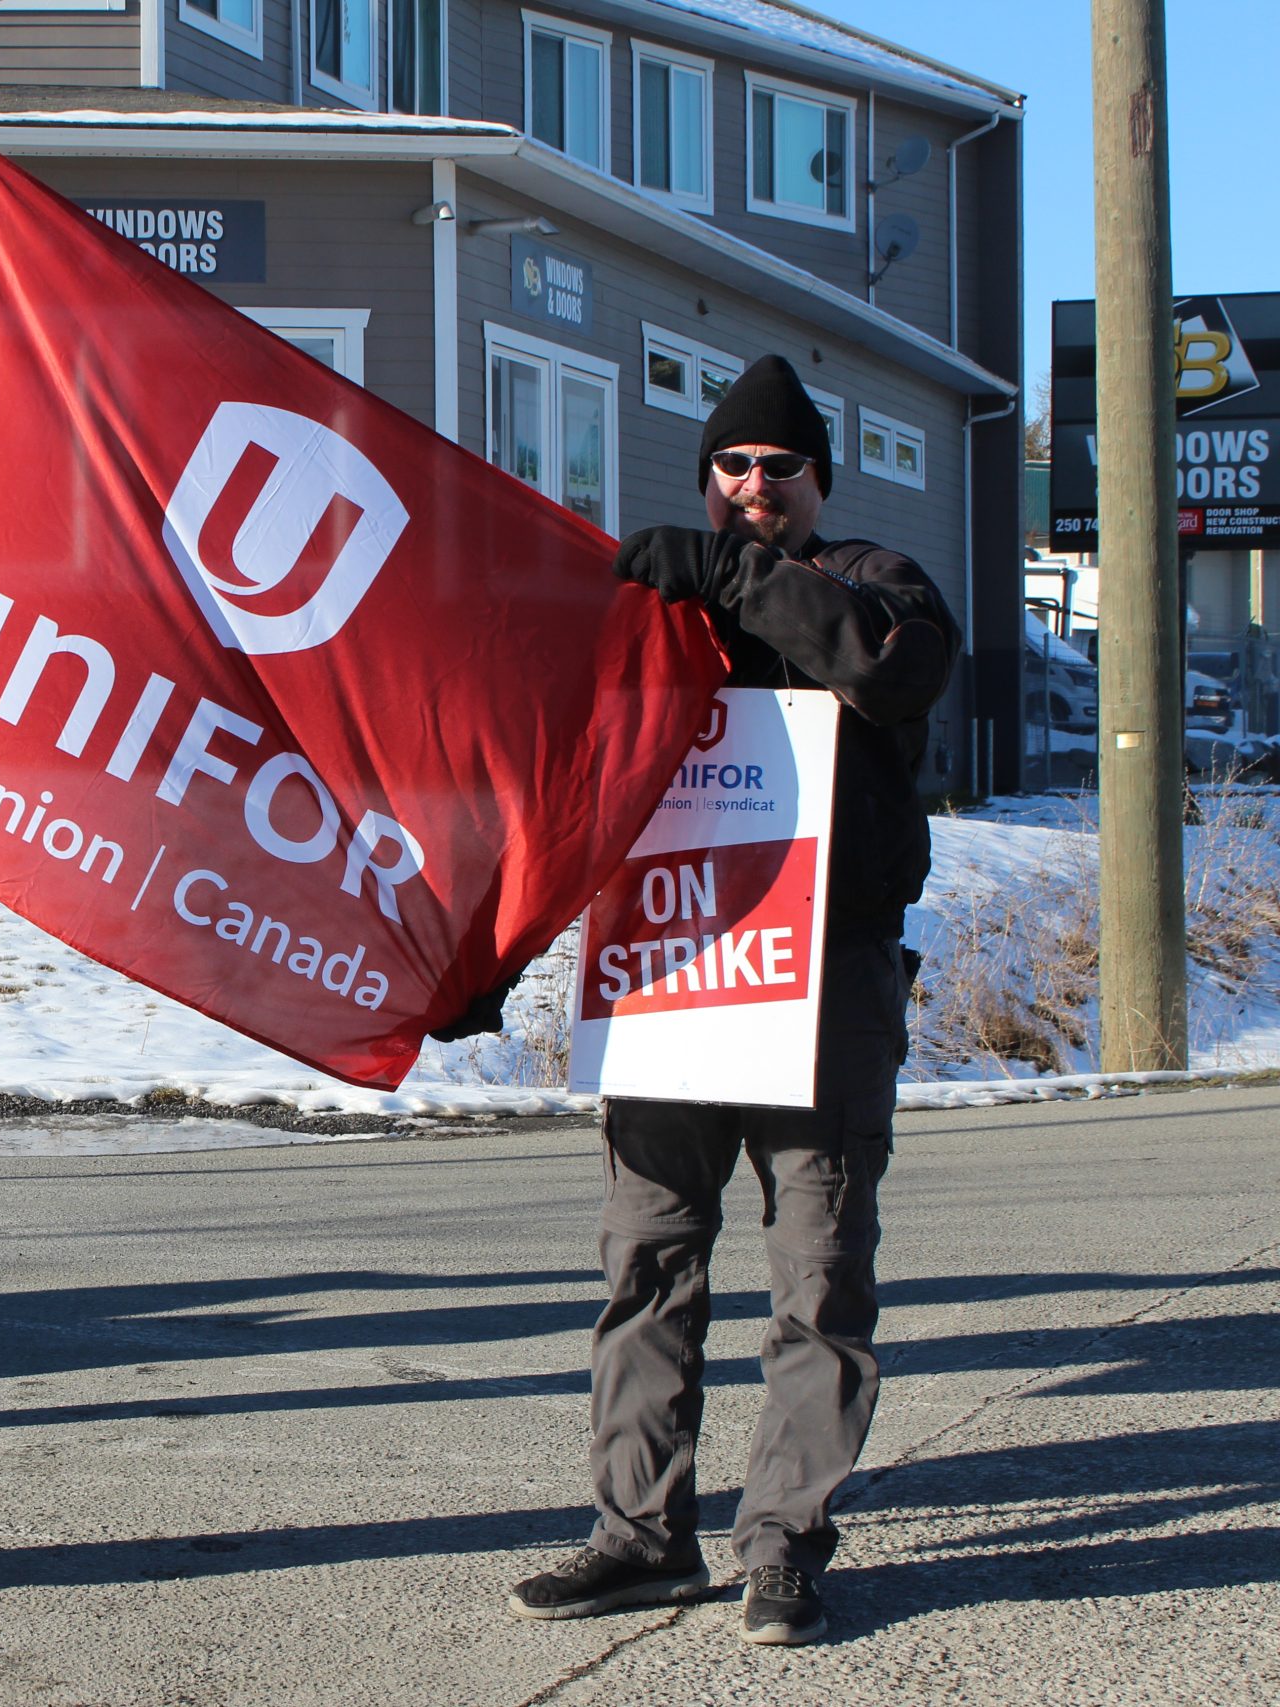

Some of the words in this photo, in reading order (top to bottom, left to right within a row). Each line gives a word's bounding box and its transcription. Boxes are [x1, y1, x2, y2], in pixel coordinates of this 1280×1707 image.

[545, 256, 584, 295] WINDOWS
[556, 290, 582, 324] DOORS
[1206, 508, 1231, 517] DOOR
[1234, 507, 1260, 516] SHOP
[1206, 517, 1227, 526] NEW
[1055, 518, 1081, 532] 250
[1206, 526, 1264, 535] RENOVATION
[656, 797, 692, 810] nion
[703, 797, 775, 813] lesyndicat
[642, 861, 718, 924] ON
[173, 868, 390, 1011] Canada
[598, 926, 797, 1001] STRIKE
